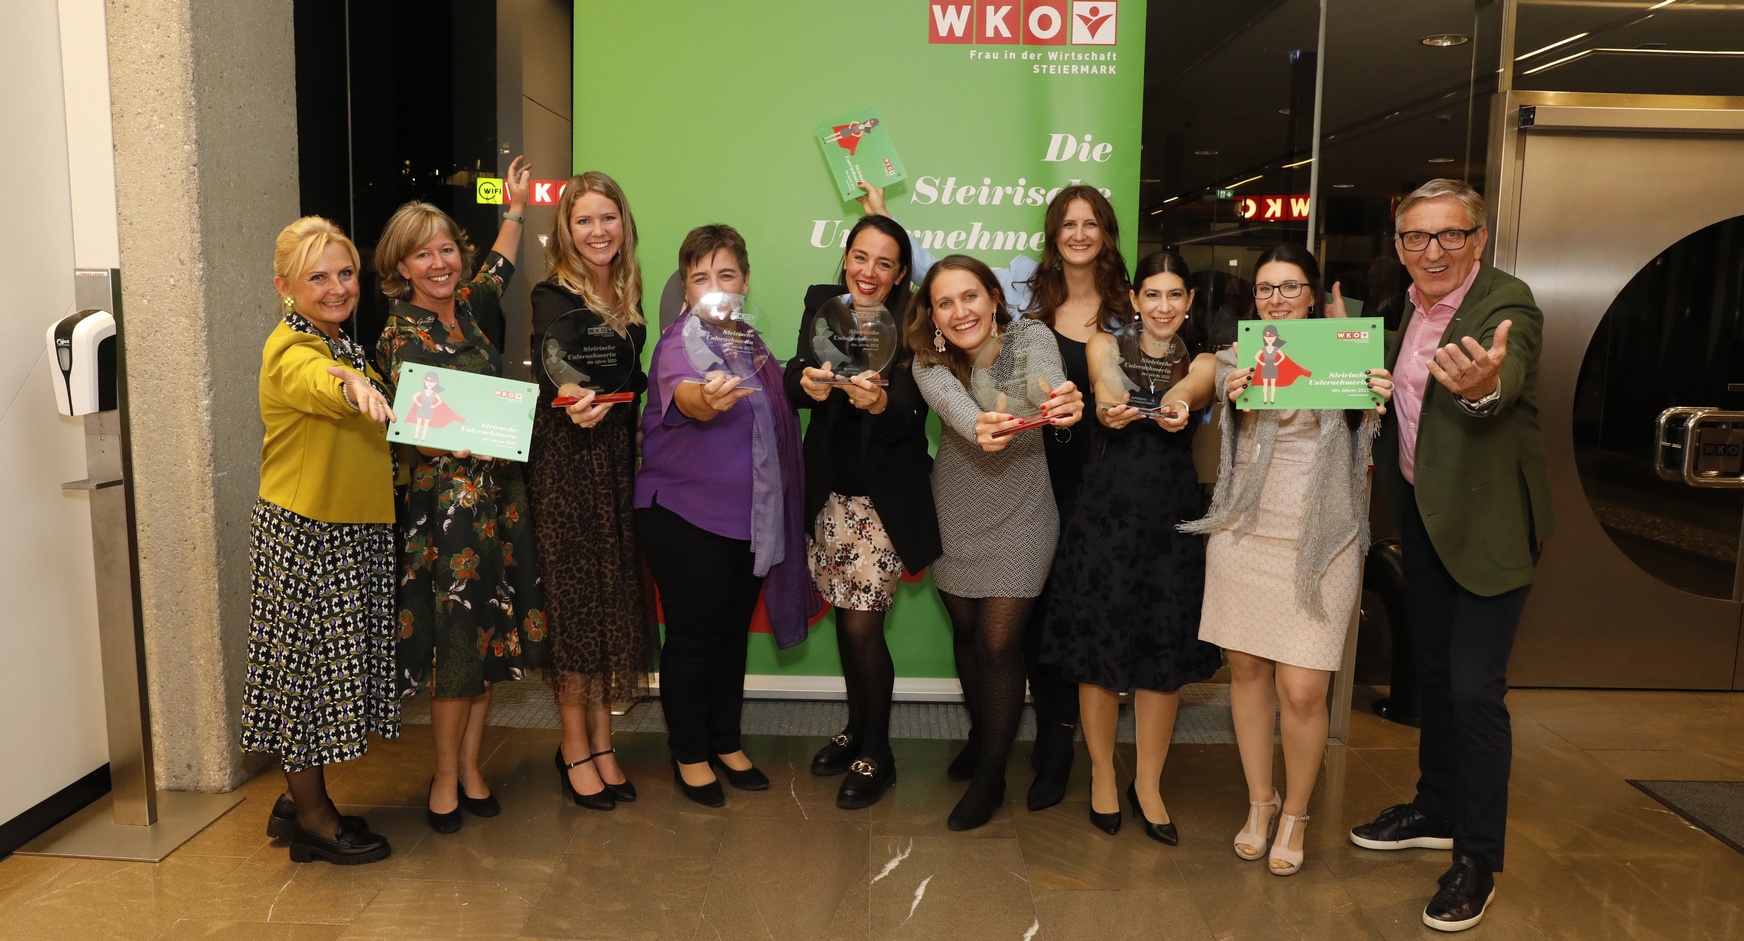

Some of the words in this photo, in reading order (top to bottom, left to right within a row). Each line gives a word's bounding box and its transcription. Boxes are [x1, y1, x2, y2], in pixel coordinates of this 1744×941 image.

[932, 4, 1062, 40] WKO
[969, 50, 999, 60] Frau
[1004, 50, 1016, 60] in
[1021, 50, 1043, 61] der
[1047, 51, 1117, 61] Wirtschaft
[1033, 64, 1117, 75] STEIERMARK
[1041, 133, 1113, 163] Die
[722, 329, 755, 338] Steirische
[568, 352, 616, 361] Unternehmerin
[1140, 357, 1173, 366] Steirische
[1124, 362, 1171, 373] Unternehmerin
[494, 390, 515, 398] WKO
[461, 426, 517, 439] Unternehmerin
[480, 423, 518, 433] Steirische
[1704, 445, 1738, 455] WKO
